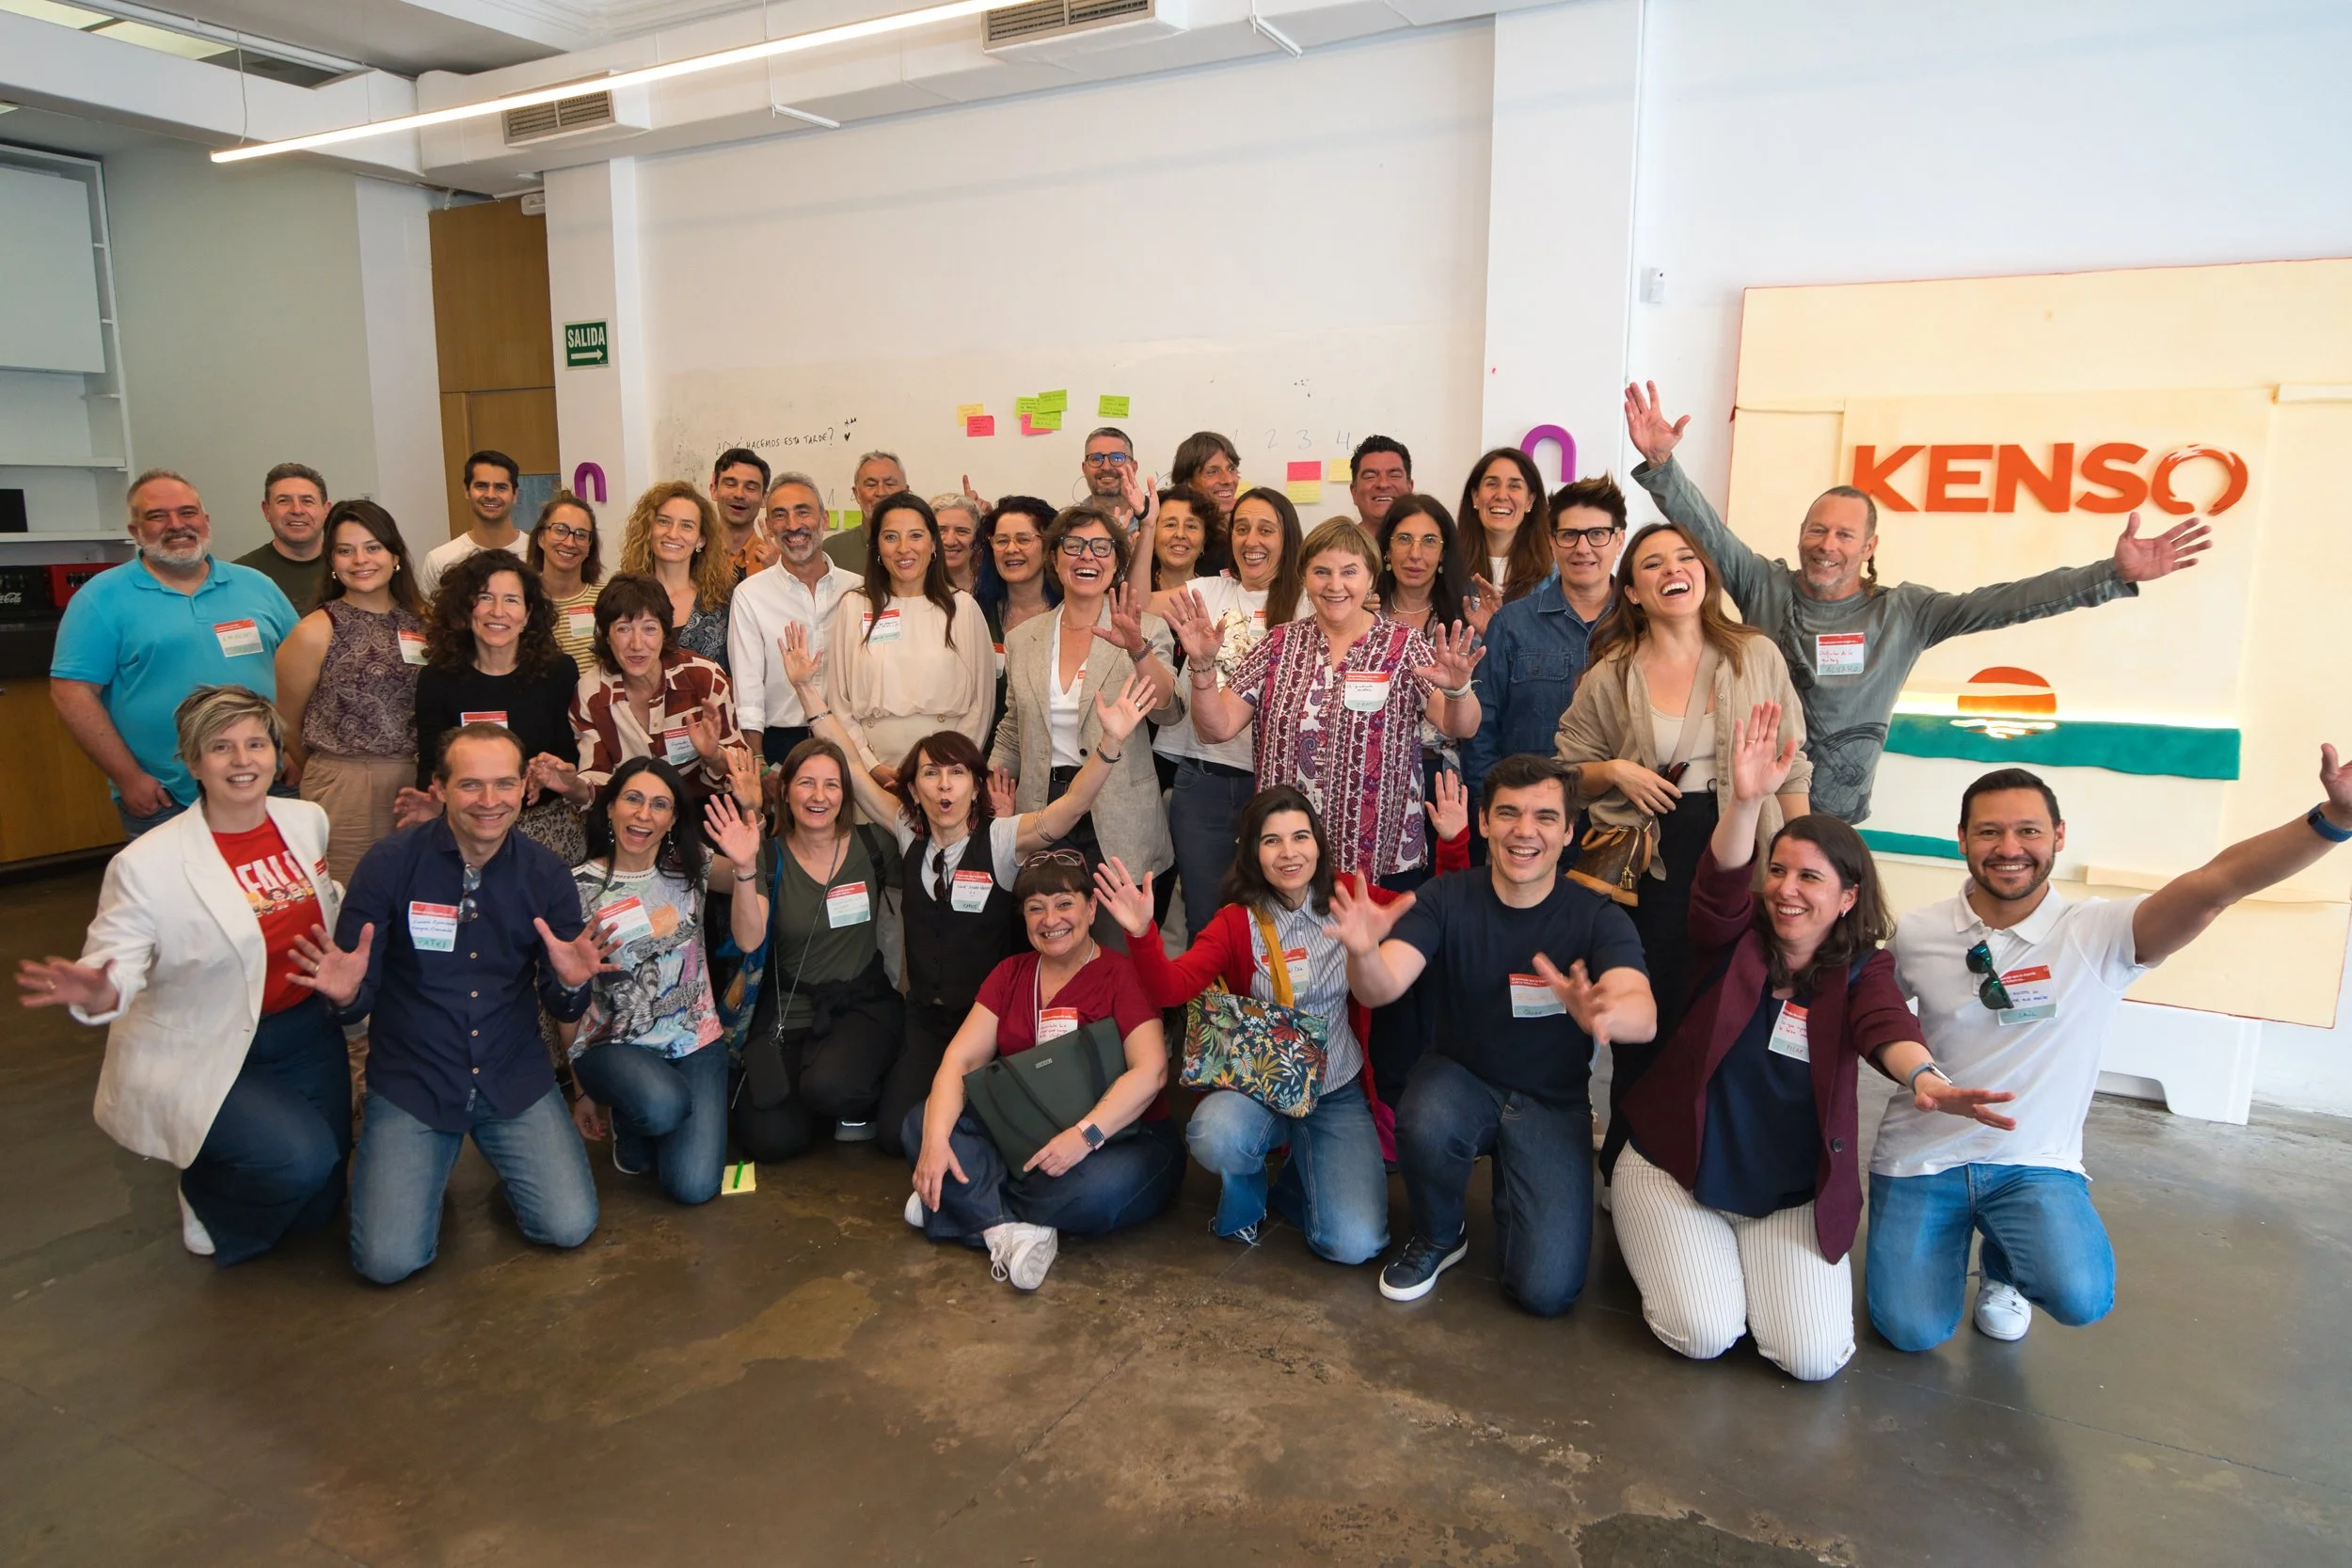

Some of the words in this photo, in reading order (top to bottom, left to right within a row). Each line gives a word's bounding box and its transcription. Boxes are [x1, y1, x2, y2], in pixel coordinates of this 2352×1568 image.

[567, 326, 606, 348] SALIDA
[746, 437, 780, 451] HACEMOS
[784, 436, 800, 446] ESTA
[803, 426, 834, 446] TARDE?
[1264, 427, 1279, 450] 2
[1295, 428, 1312, 451] 3
[1336, 430, 1351, 451] 4
[1851, 442, 2249, 517] KENSO
